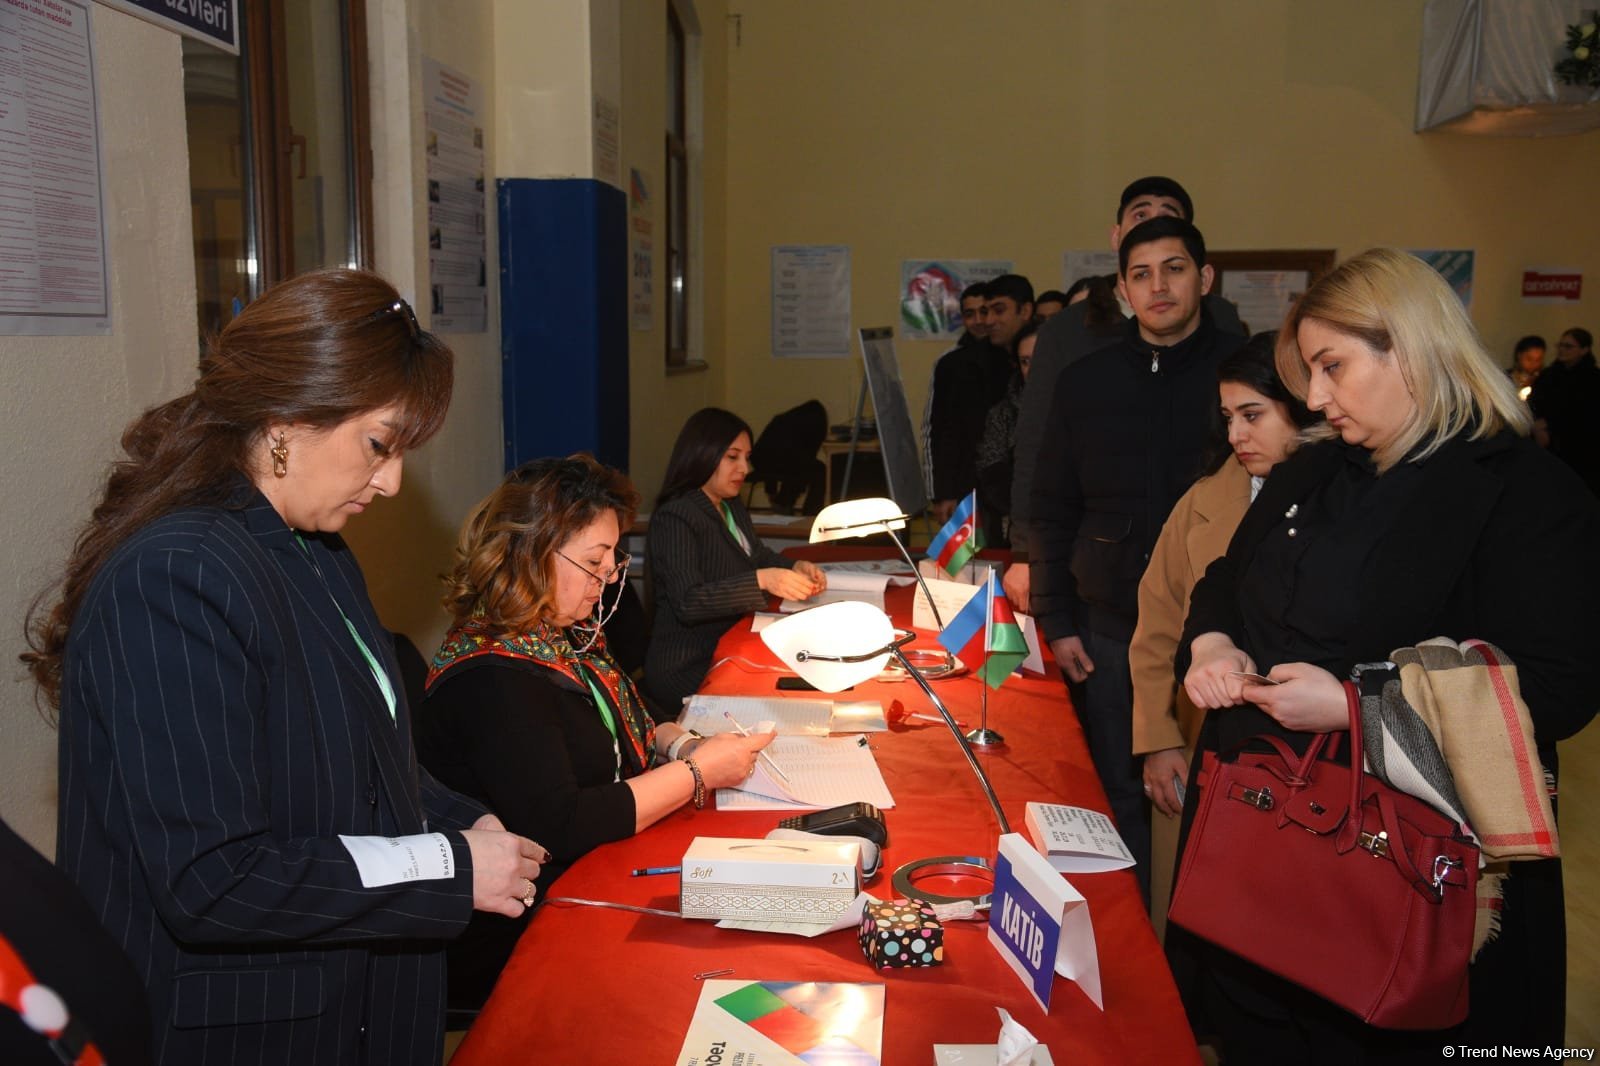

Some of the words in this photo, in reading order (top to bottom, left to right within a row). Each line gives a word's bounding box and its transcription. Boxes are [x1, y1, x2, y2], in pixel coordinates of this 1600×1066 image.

[165, 0, 227, 31] zvləri
[690, 866, 714, 880] Soft
[1000, 891, 1045, 970] KATİB
